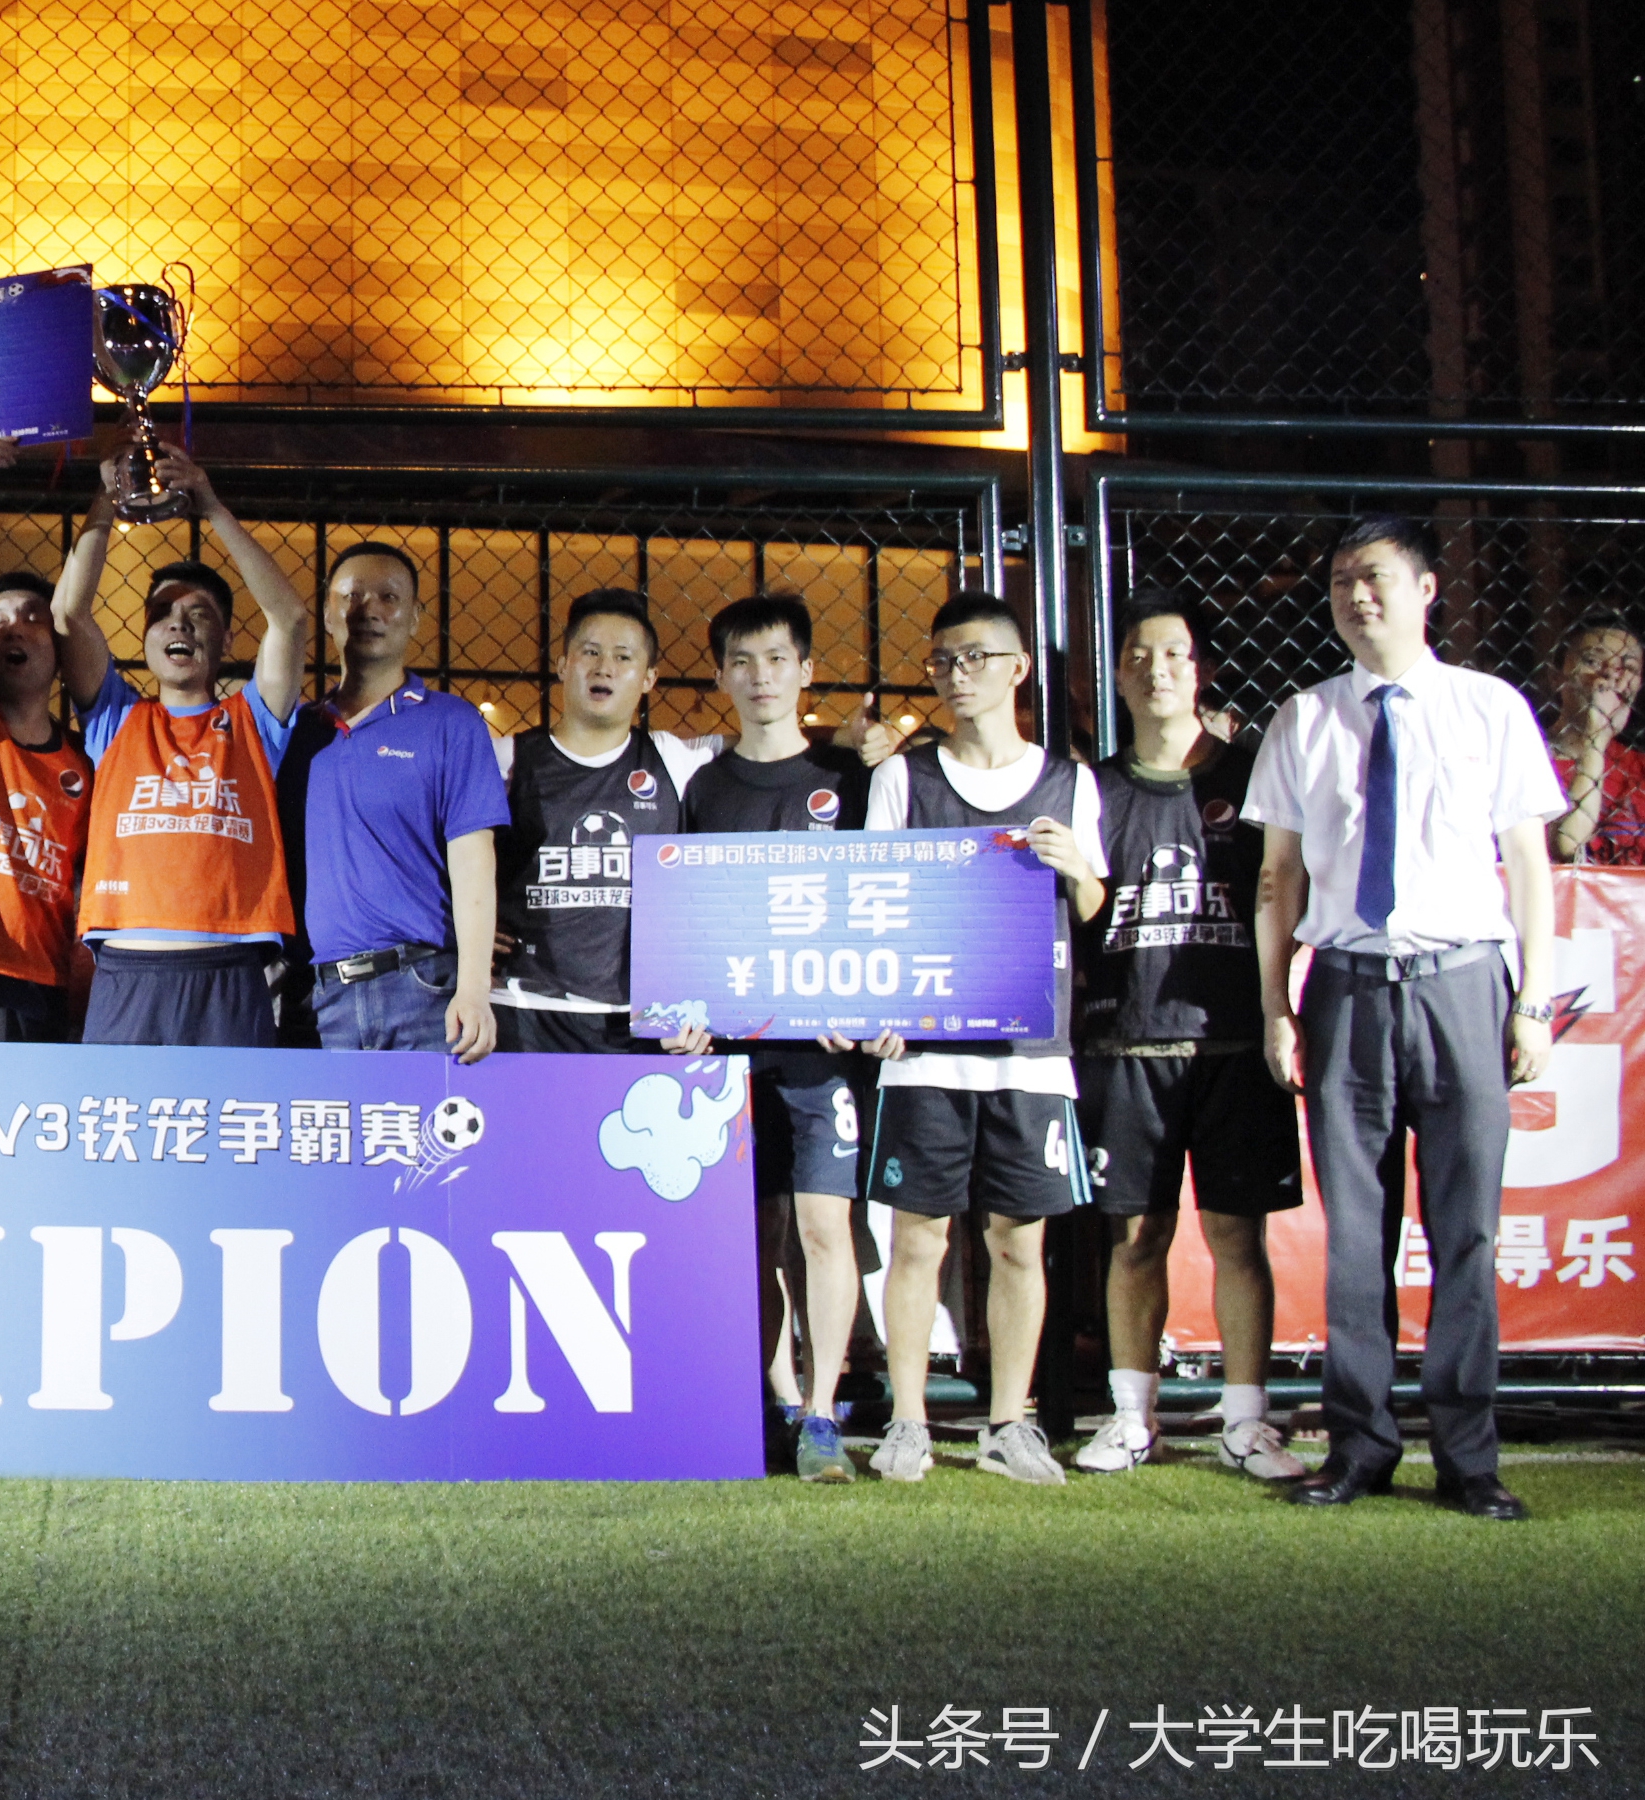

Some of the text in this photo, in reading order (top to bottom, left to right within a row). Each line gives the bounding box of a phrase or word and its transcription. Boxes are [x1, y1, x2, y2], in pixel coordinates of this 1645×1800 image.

[388, 749, 415, 759] pepsi
[128, 774, 242, 815] 百事可乐
[538, 846, 632, 884] 百事可
[683, 840, 959, 865] 百事可乐足球3V3铁笼争霸赛
[767, 872, 910, 937] 季军
[1111, 881, 1237, 926] 百事可乐
[726, 948, 954, 996] ¥1000元
